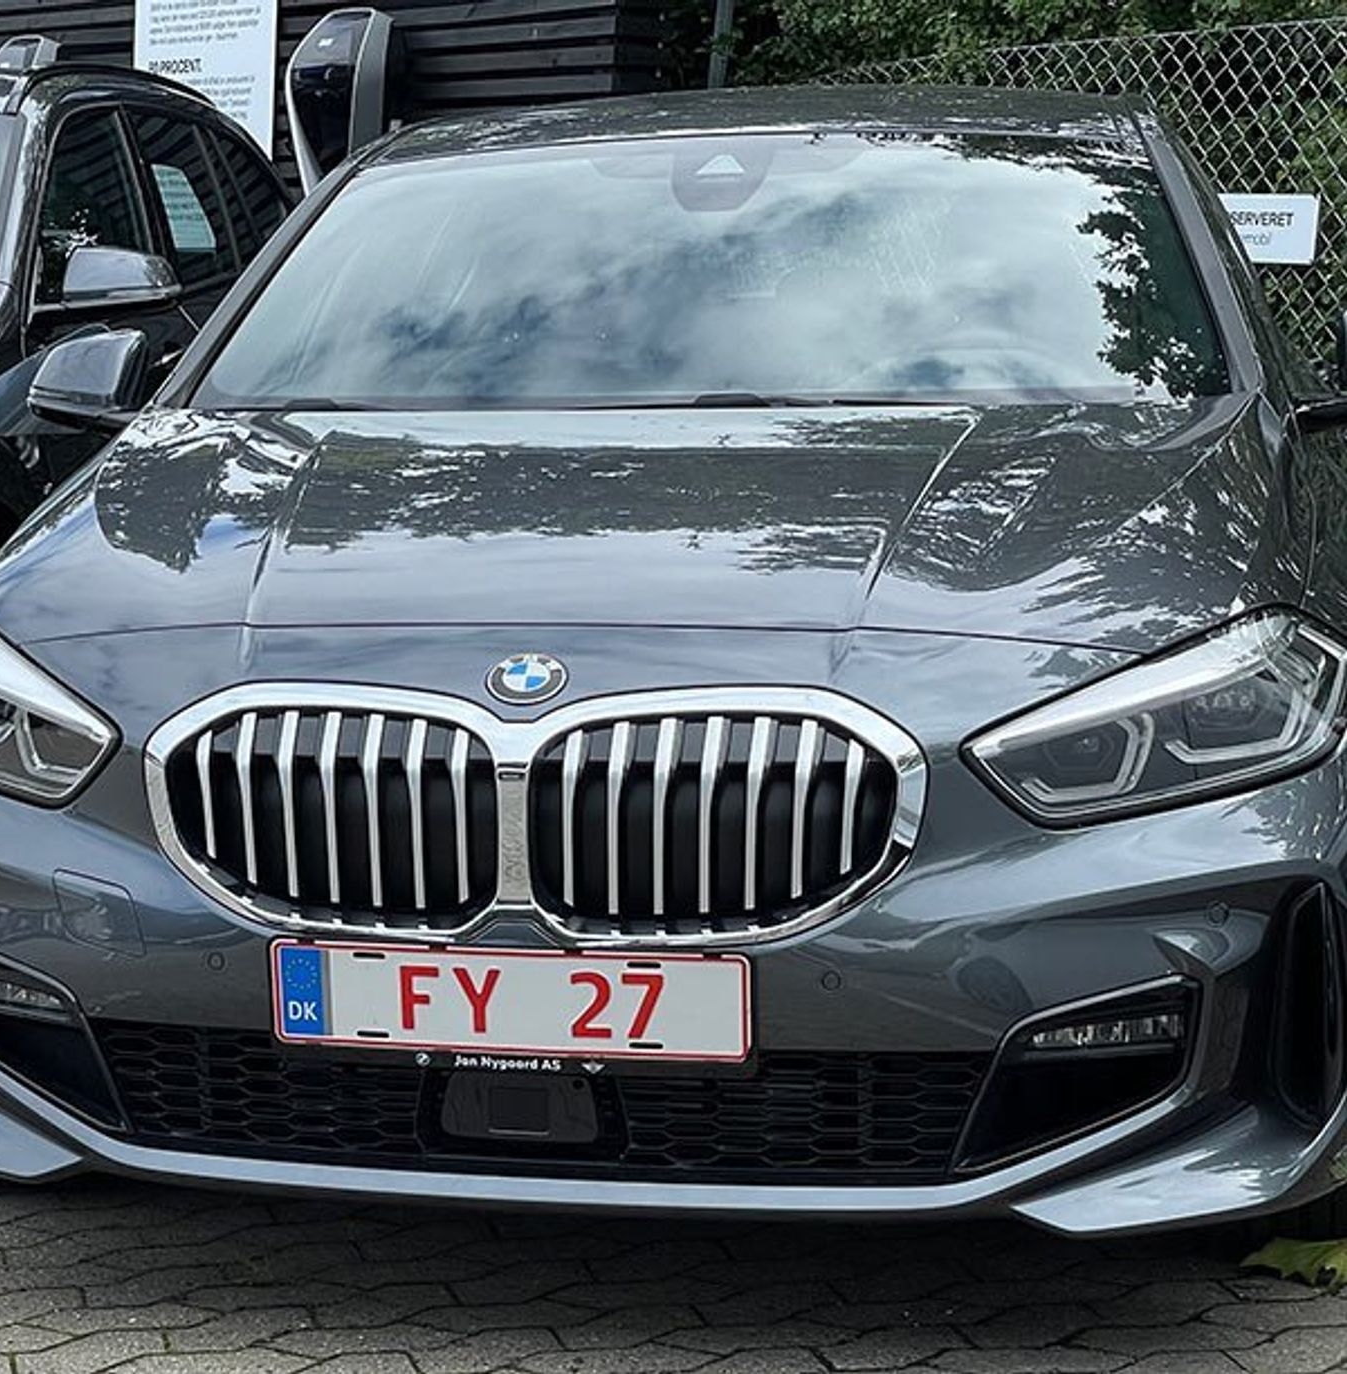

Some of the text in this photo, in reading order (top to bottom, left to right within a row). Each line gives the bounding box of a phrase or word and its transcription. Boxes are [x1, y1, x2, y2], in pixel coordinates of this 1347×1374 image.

[289, 1001, 318, 1021] DK
[399, 965, 666, 1040] FY 27
[454, 1055, 561, 1071] Jan Nygaard AS
